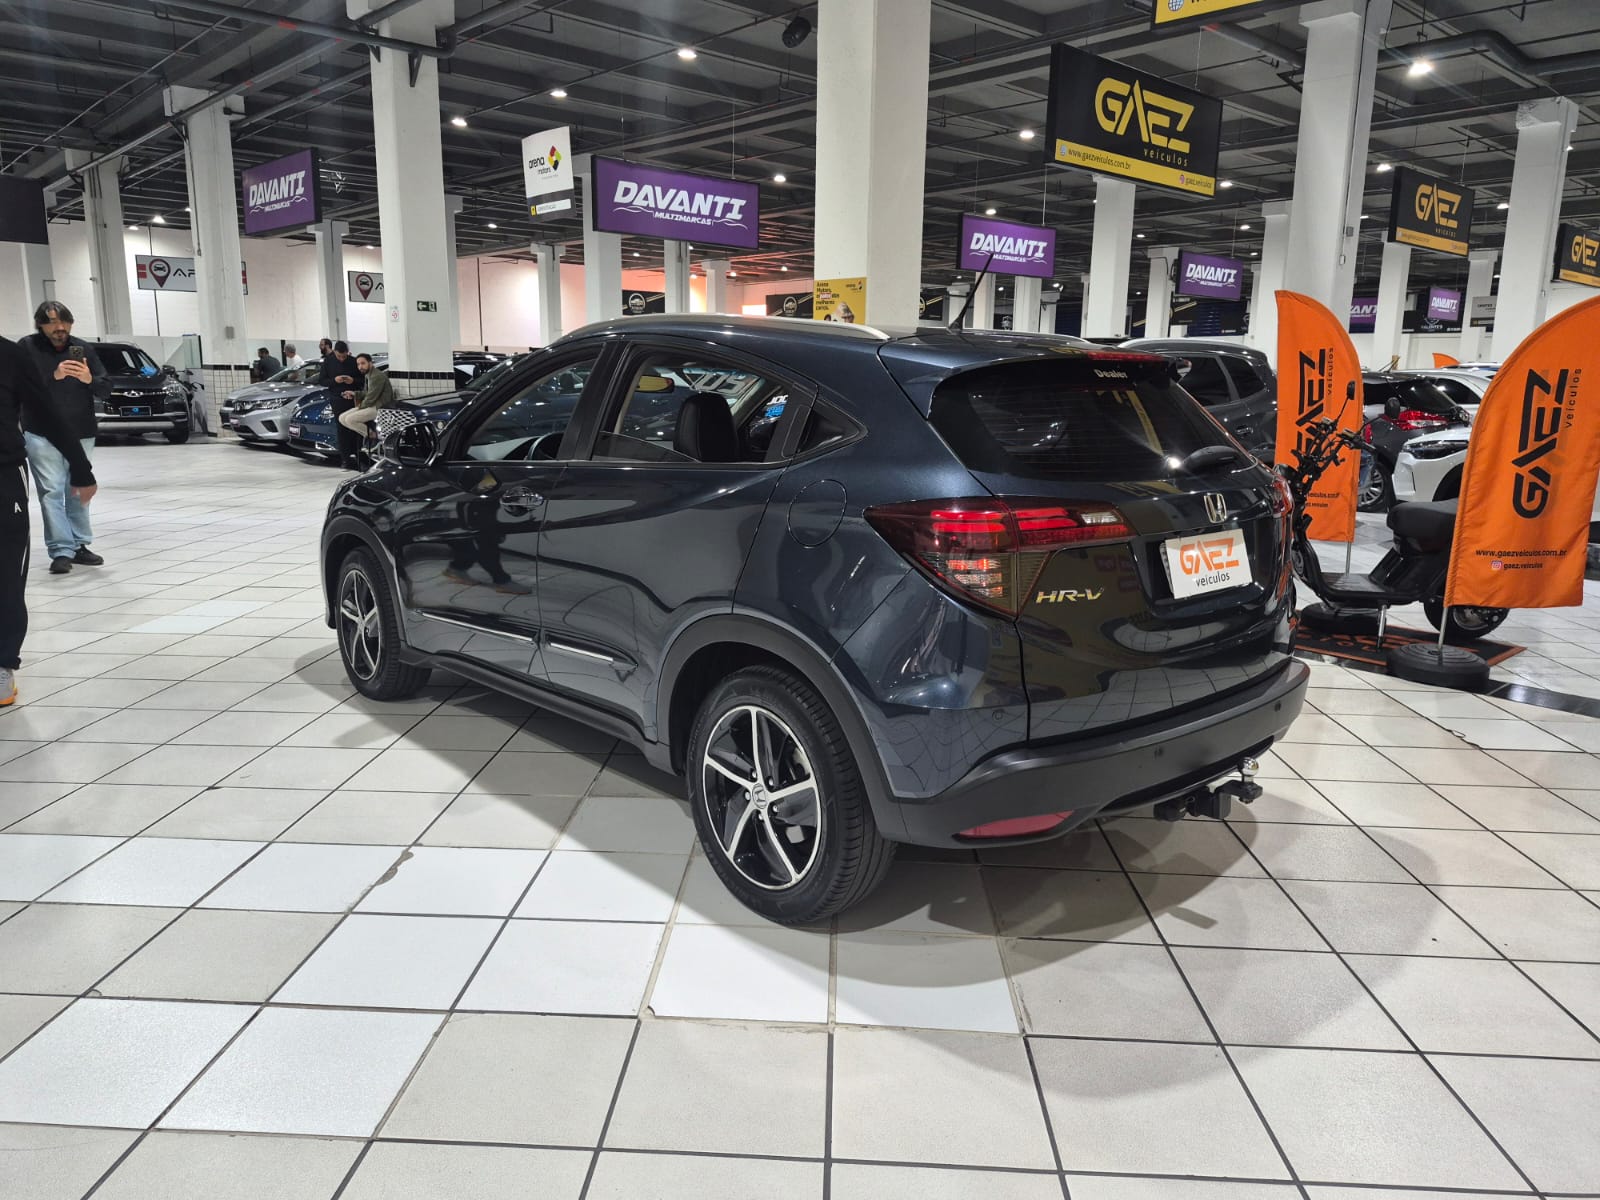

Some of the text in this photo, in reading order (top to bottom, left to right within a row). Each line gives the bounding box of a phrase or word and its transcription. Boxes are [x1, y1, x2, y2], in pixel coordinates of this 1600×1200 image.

[249, 170, 306, 207] DAVANTI
[613, 180, 747, 220] DAVANTI
[654, 211, 712, 225] MULTIMARCAS
[970, 232, 1048, 258] DAVANTI
[1185, 263, 1237, 283] DAVANTI
[1093, 368, 1128, 378] Dealer
[1036, 587, 1104, 604] HR-V
